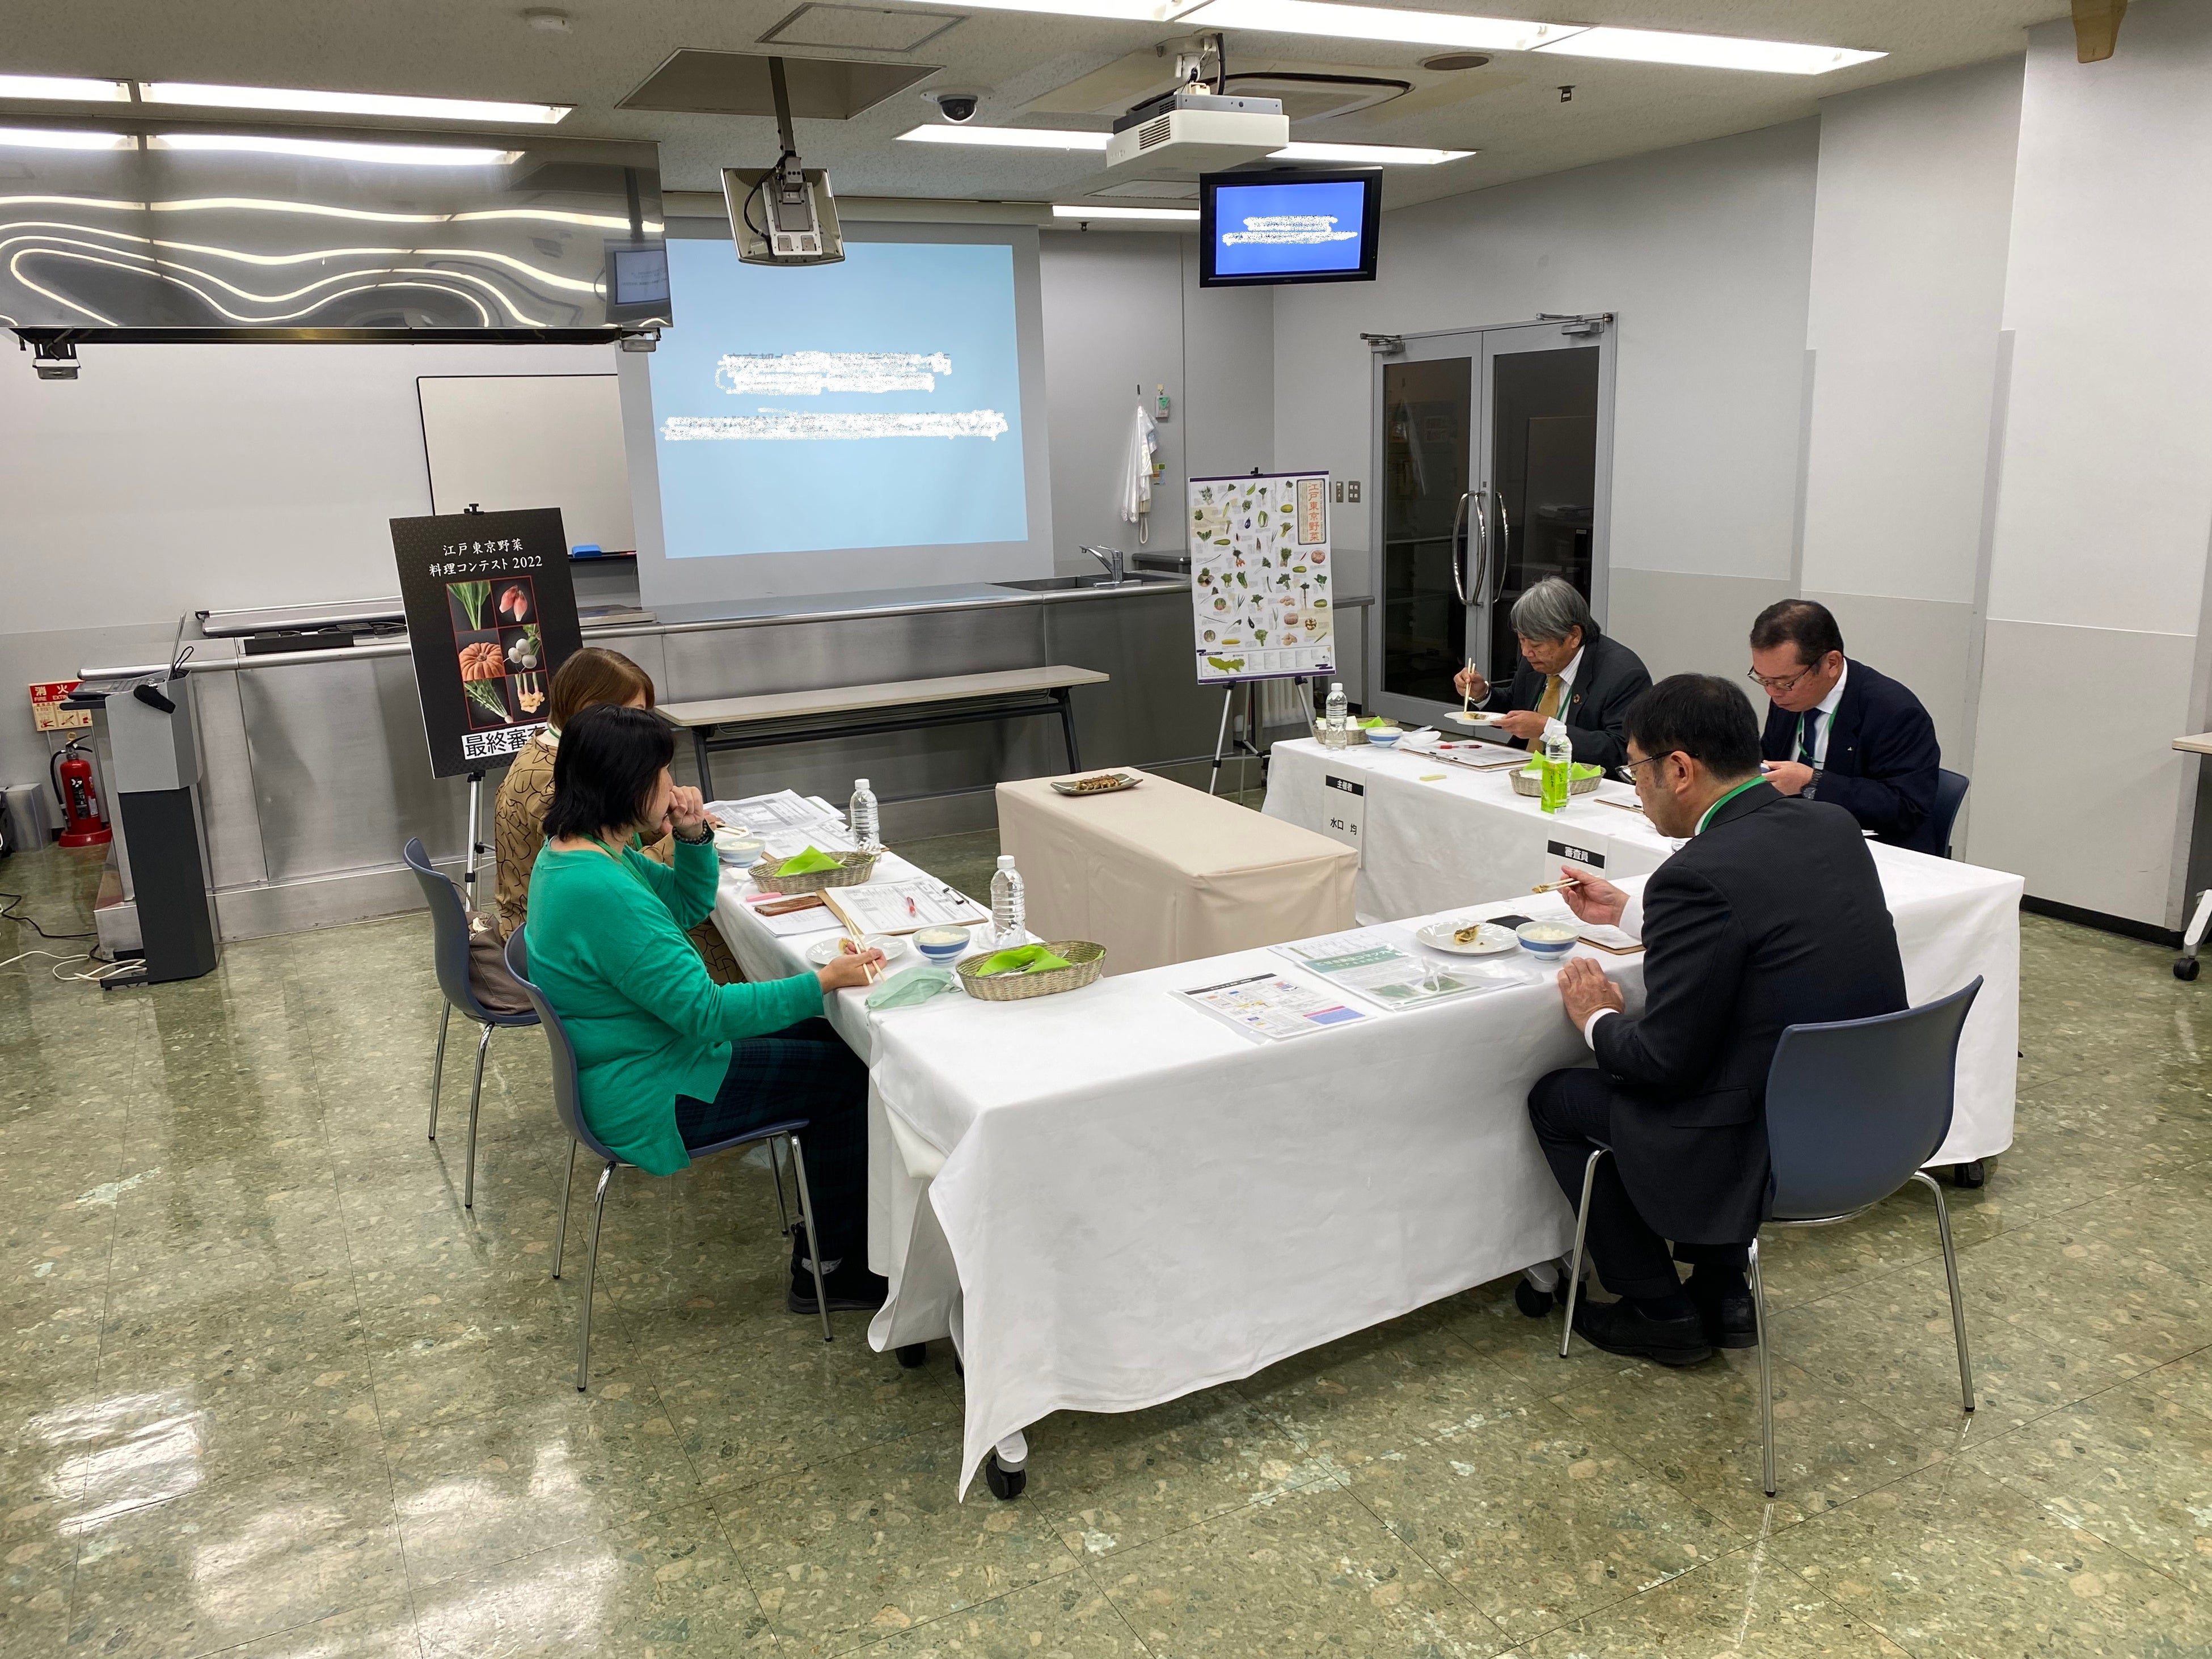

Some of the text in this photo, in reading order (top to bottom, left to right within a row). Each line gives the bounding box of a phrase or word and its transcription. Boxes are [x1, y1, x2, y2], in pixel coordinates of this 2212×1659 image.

[1308, 484, 1320, 542] 江戸東京野菜
[443, 538, 523, 556] 江戸東京野菜
[429, 555, 543, 577] 料理コンテスト 2022
[1330, 817, 1357, 835] 水口 均
[1565, 846, 1589, 863] 審査員
